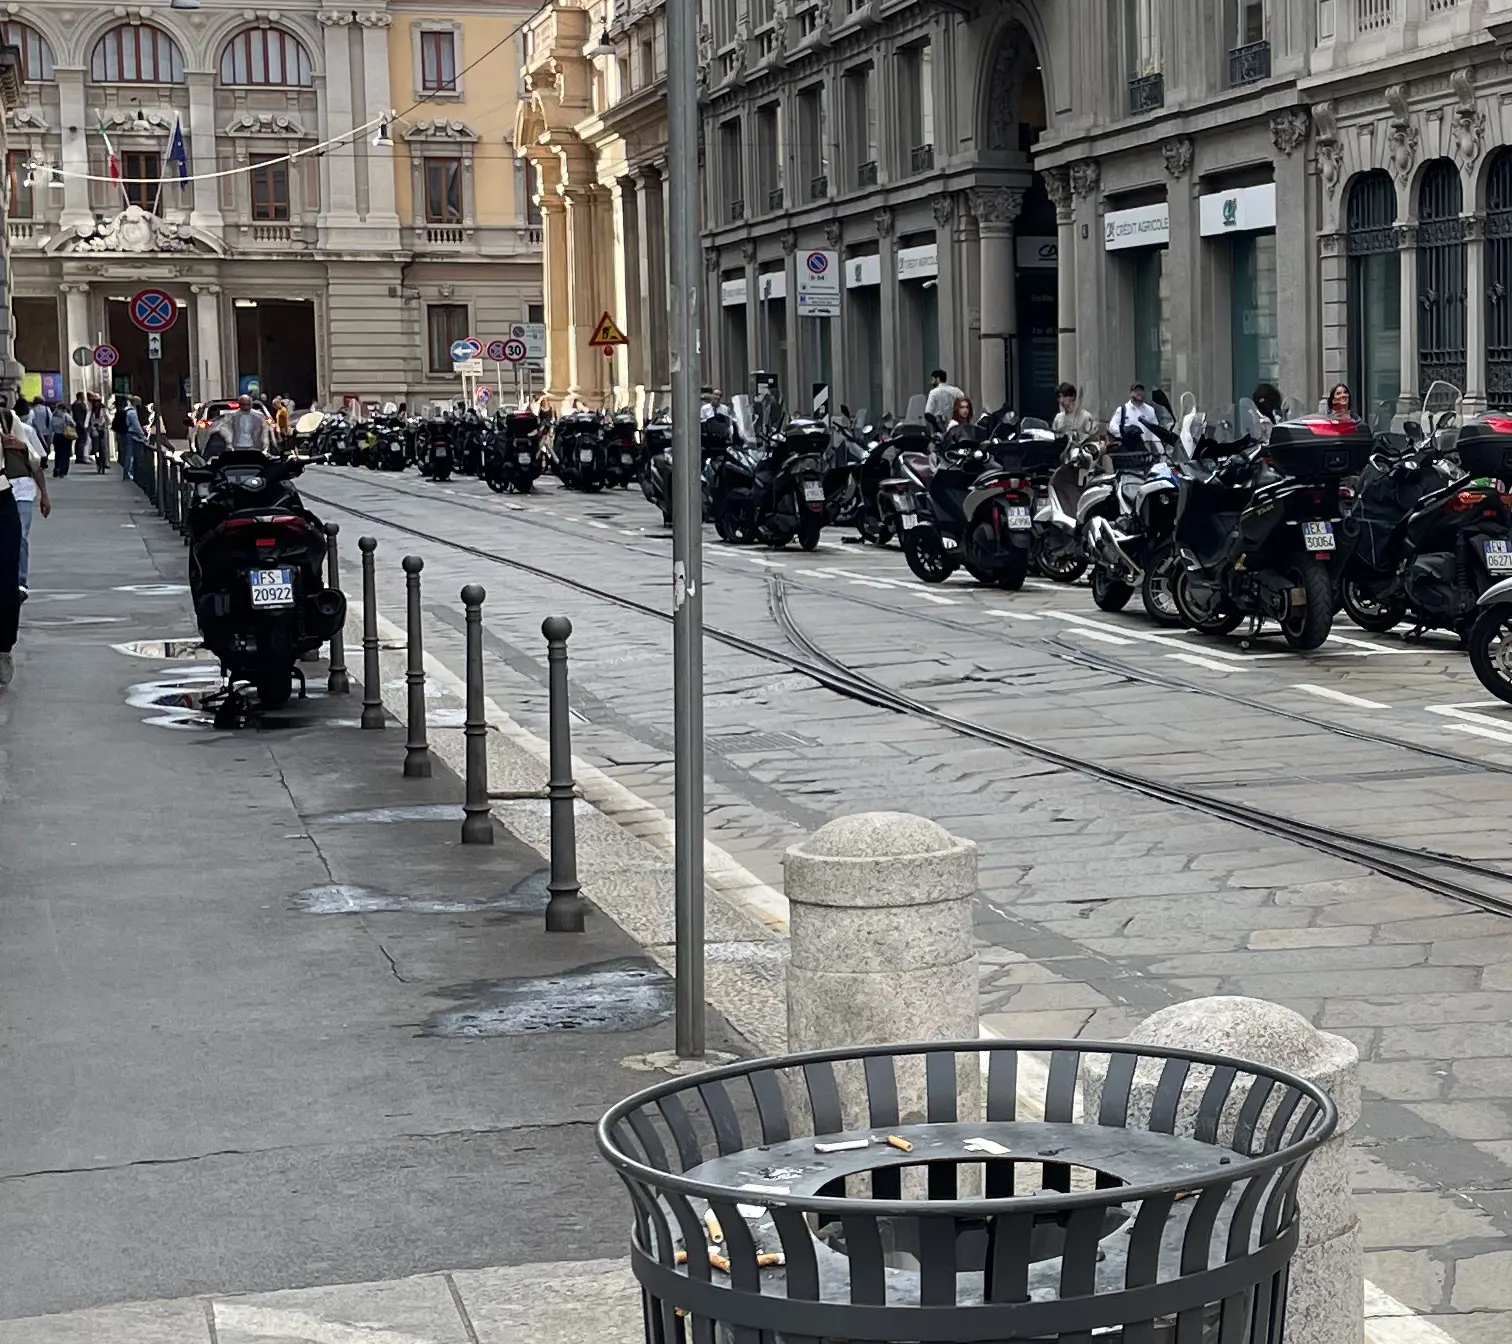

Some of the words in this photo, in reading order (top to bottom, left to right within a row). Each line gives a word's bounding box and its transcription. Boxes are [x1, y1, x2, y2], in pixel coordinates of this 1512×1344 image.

[508, 344, 521, 356] 30
[261, 571, 276, 585] FS
[254, 587, 292, 602] 20922
